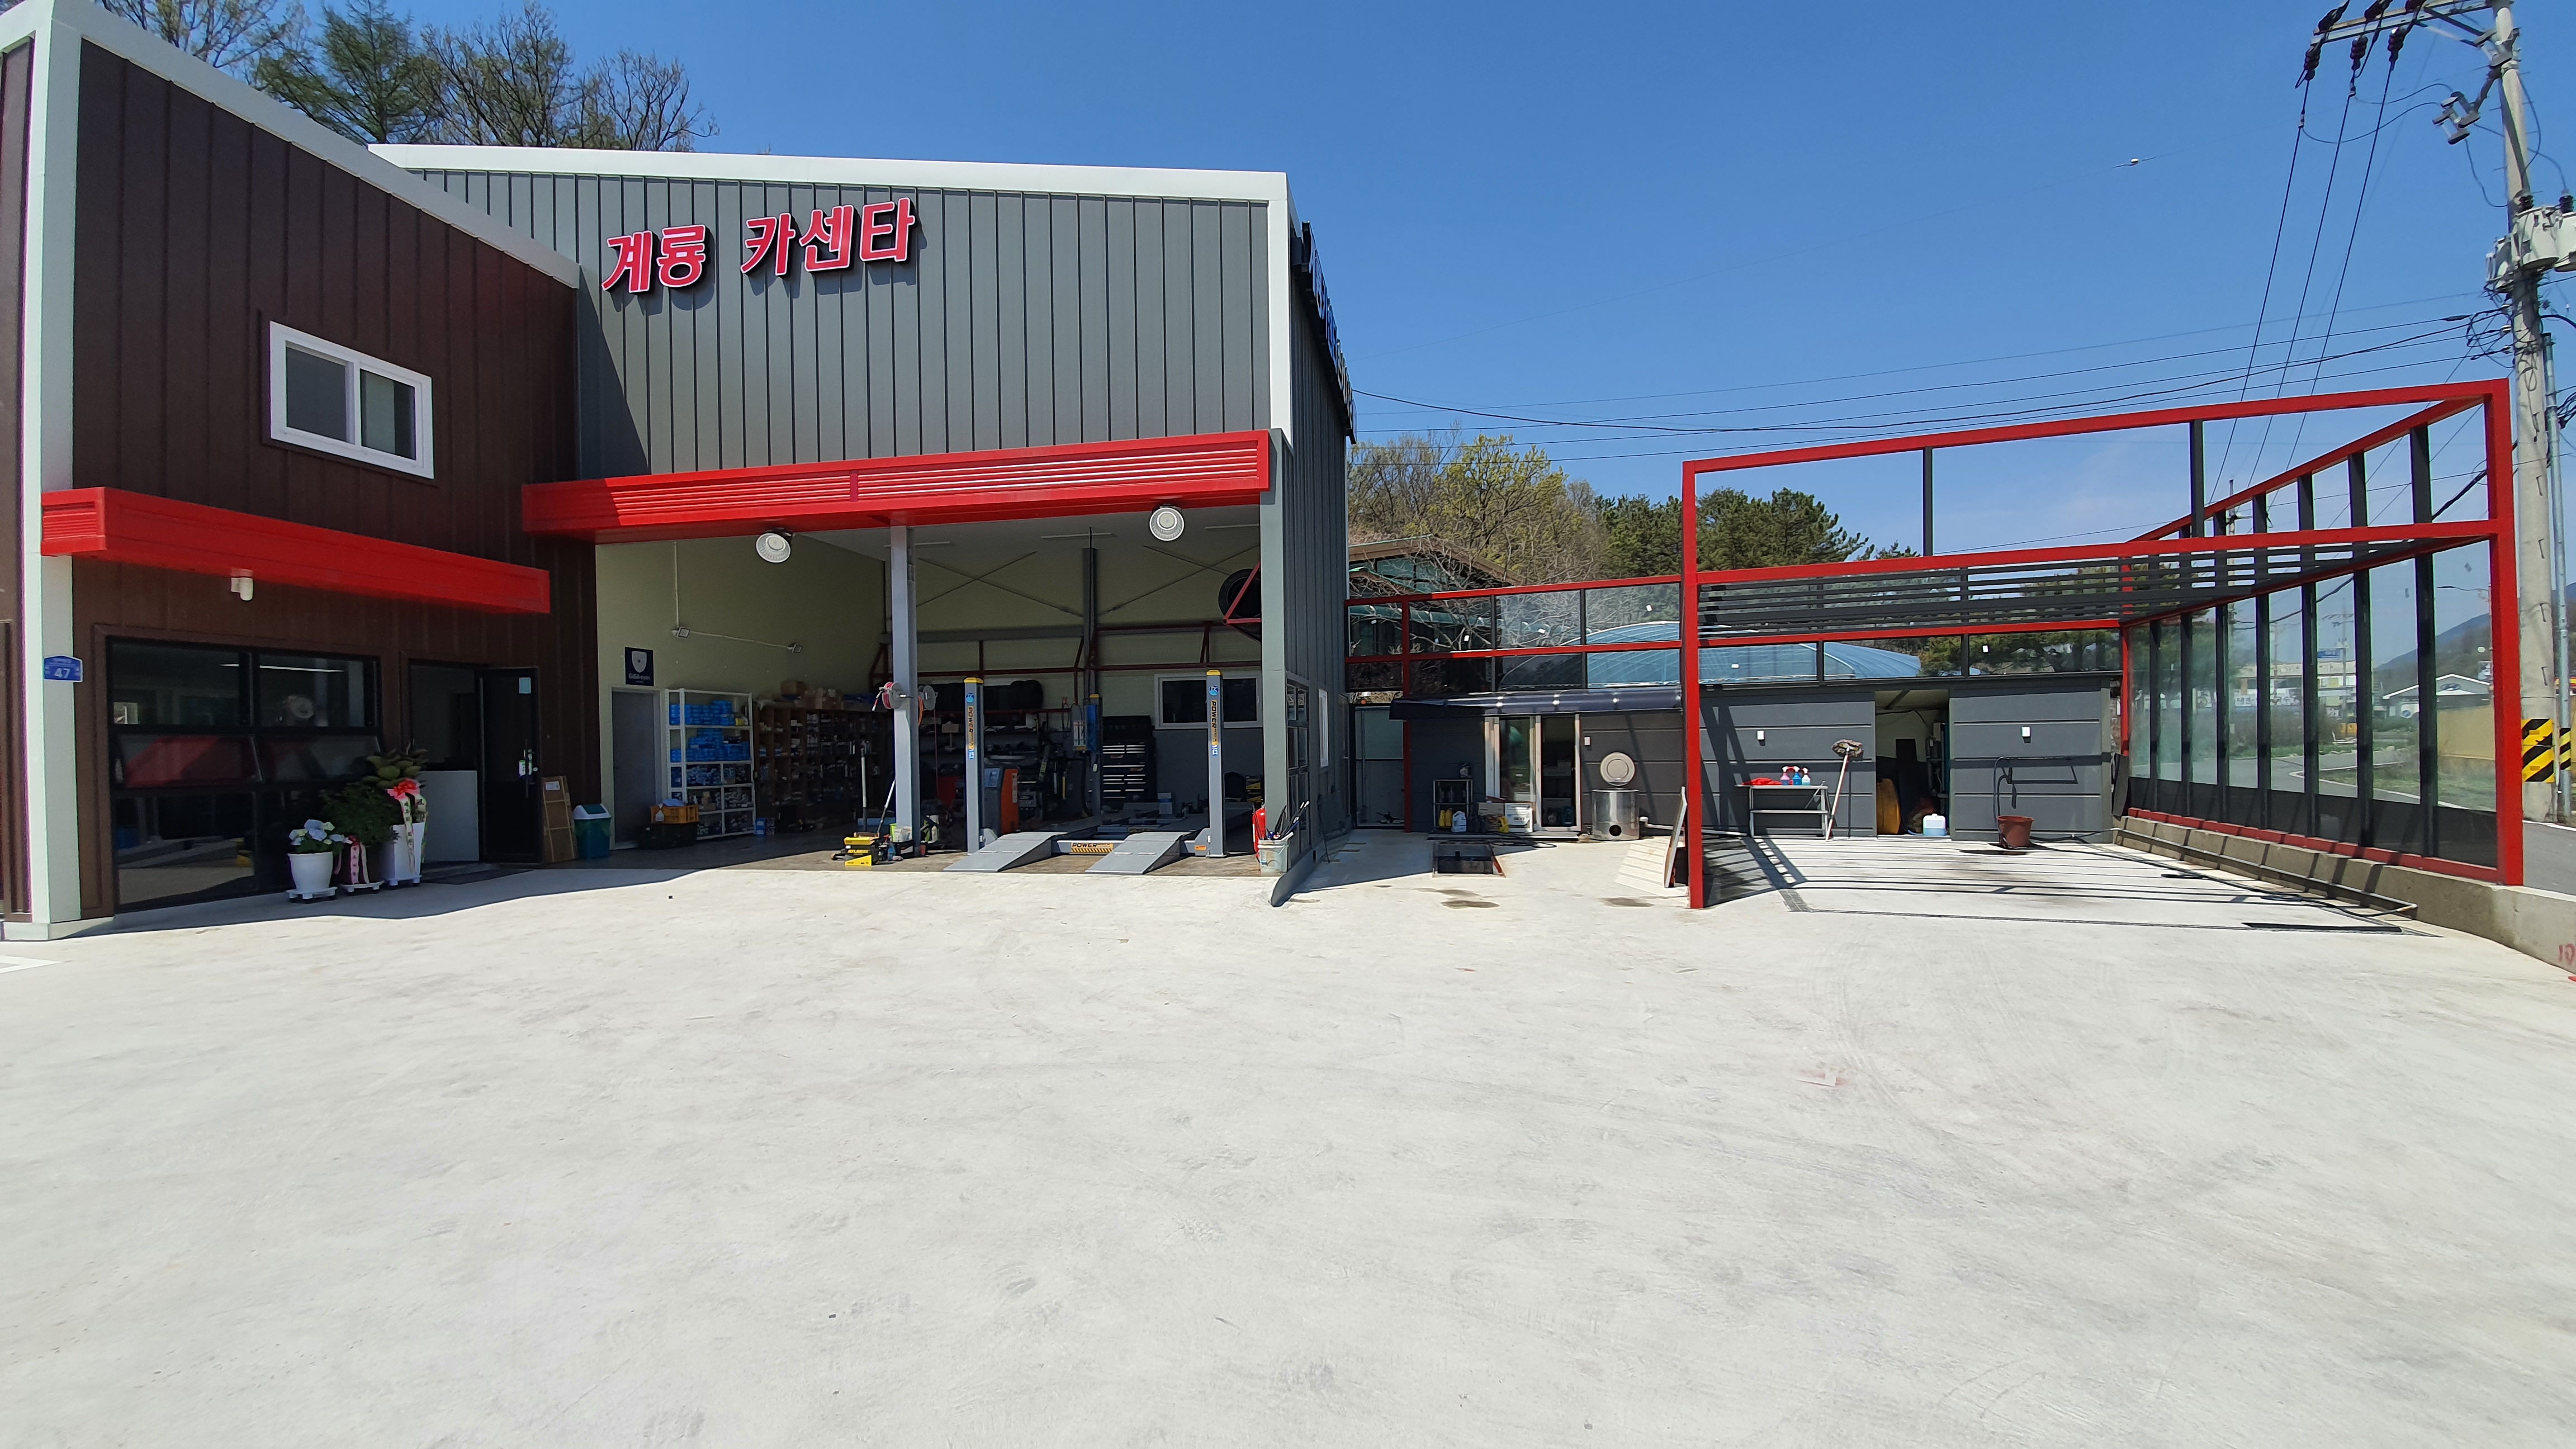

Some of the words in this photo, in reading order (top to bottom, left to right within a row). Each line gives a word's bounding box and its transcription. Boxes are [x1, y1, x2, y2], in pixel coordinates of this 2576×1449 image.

[601, 224, 708, 293] 계룡
[740, 197, 916, 276] 카센타
[54, 667, 71, 679] 47
